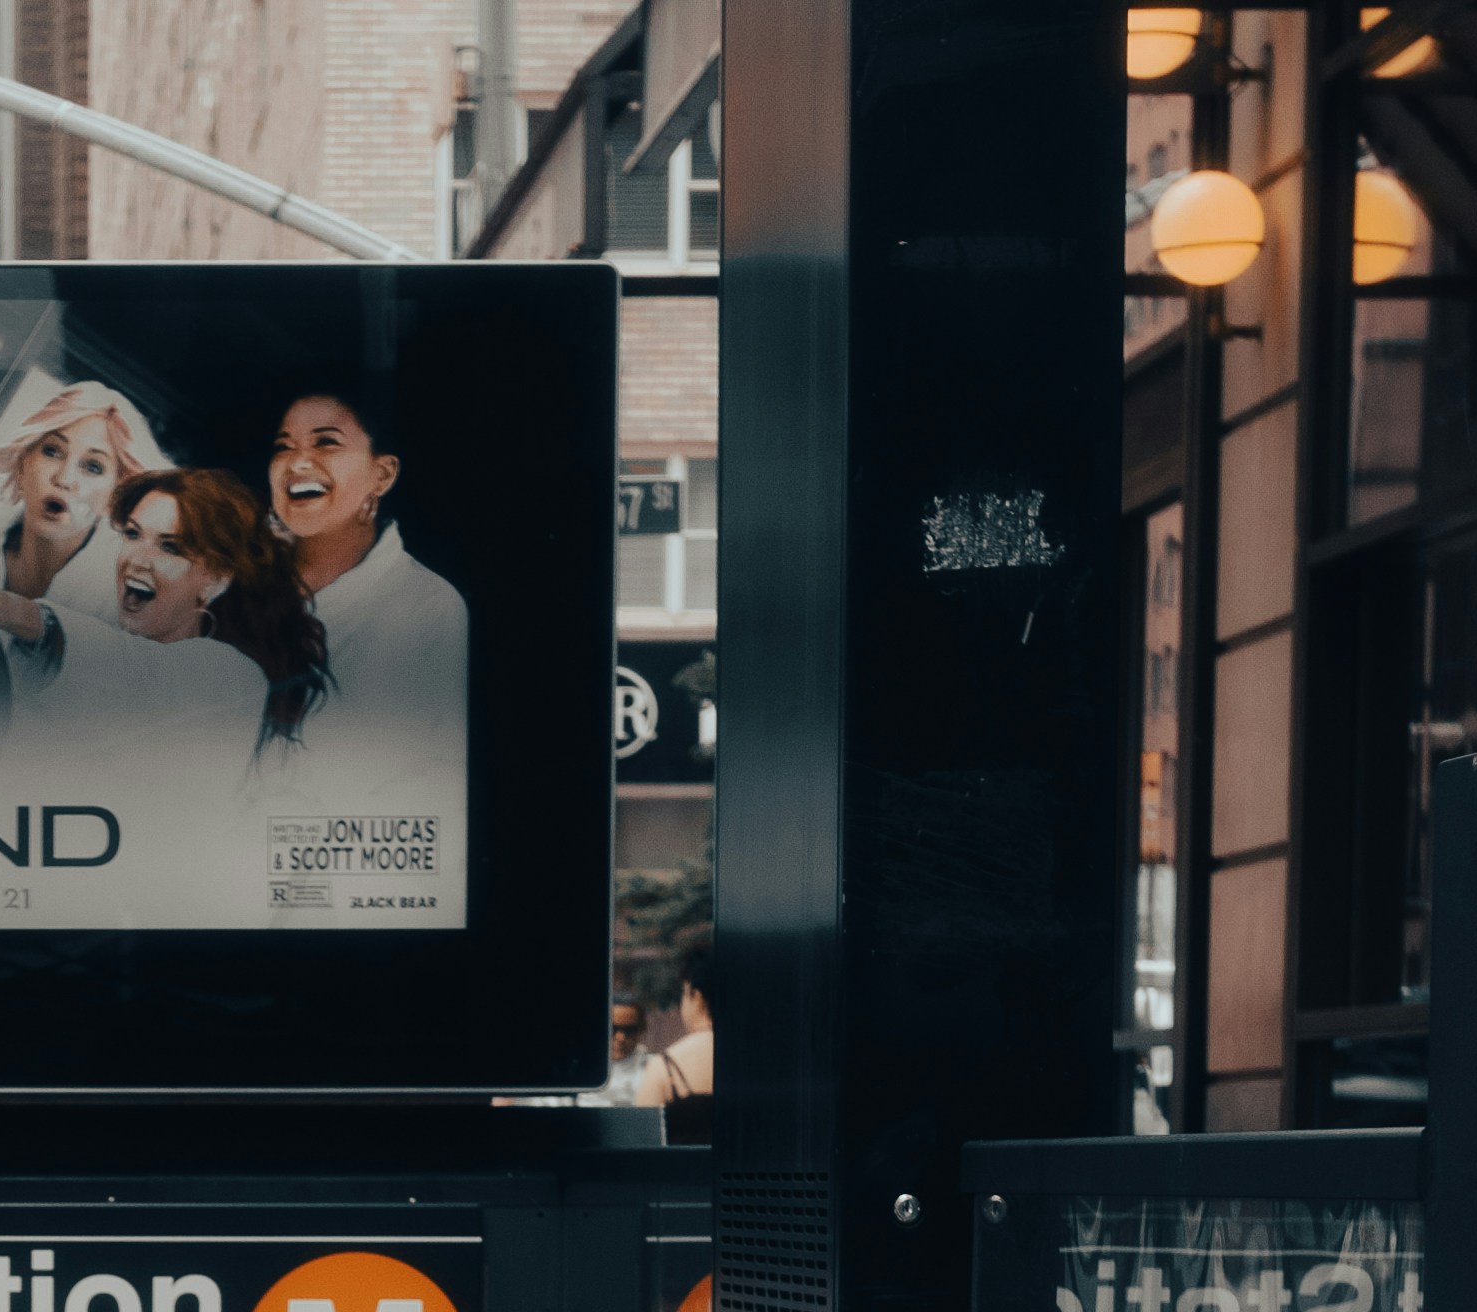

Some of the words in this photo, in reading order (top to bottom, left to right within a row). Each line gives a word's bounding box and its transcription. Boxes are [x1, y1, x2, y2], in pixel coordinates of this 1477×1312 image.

[322, 819, 364, 843] JON
[371, 819, 436, 843] LUCAS
[289, 847, 355, 870] SCOTT
[360, 847, 435, 870] MOORE
[4, 886, 32, 910] 21
[398, 896, 438, 909] BEAR
